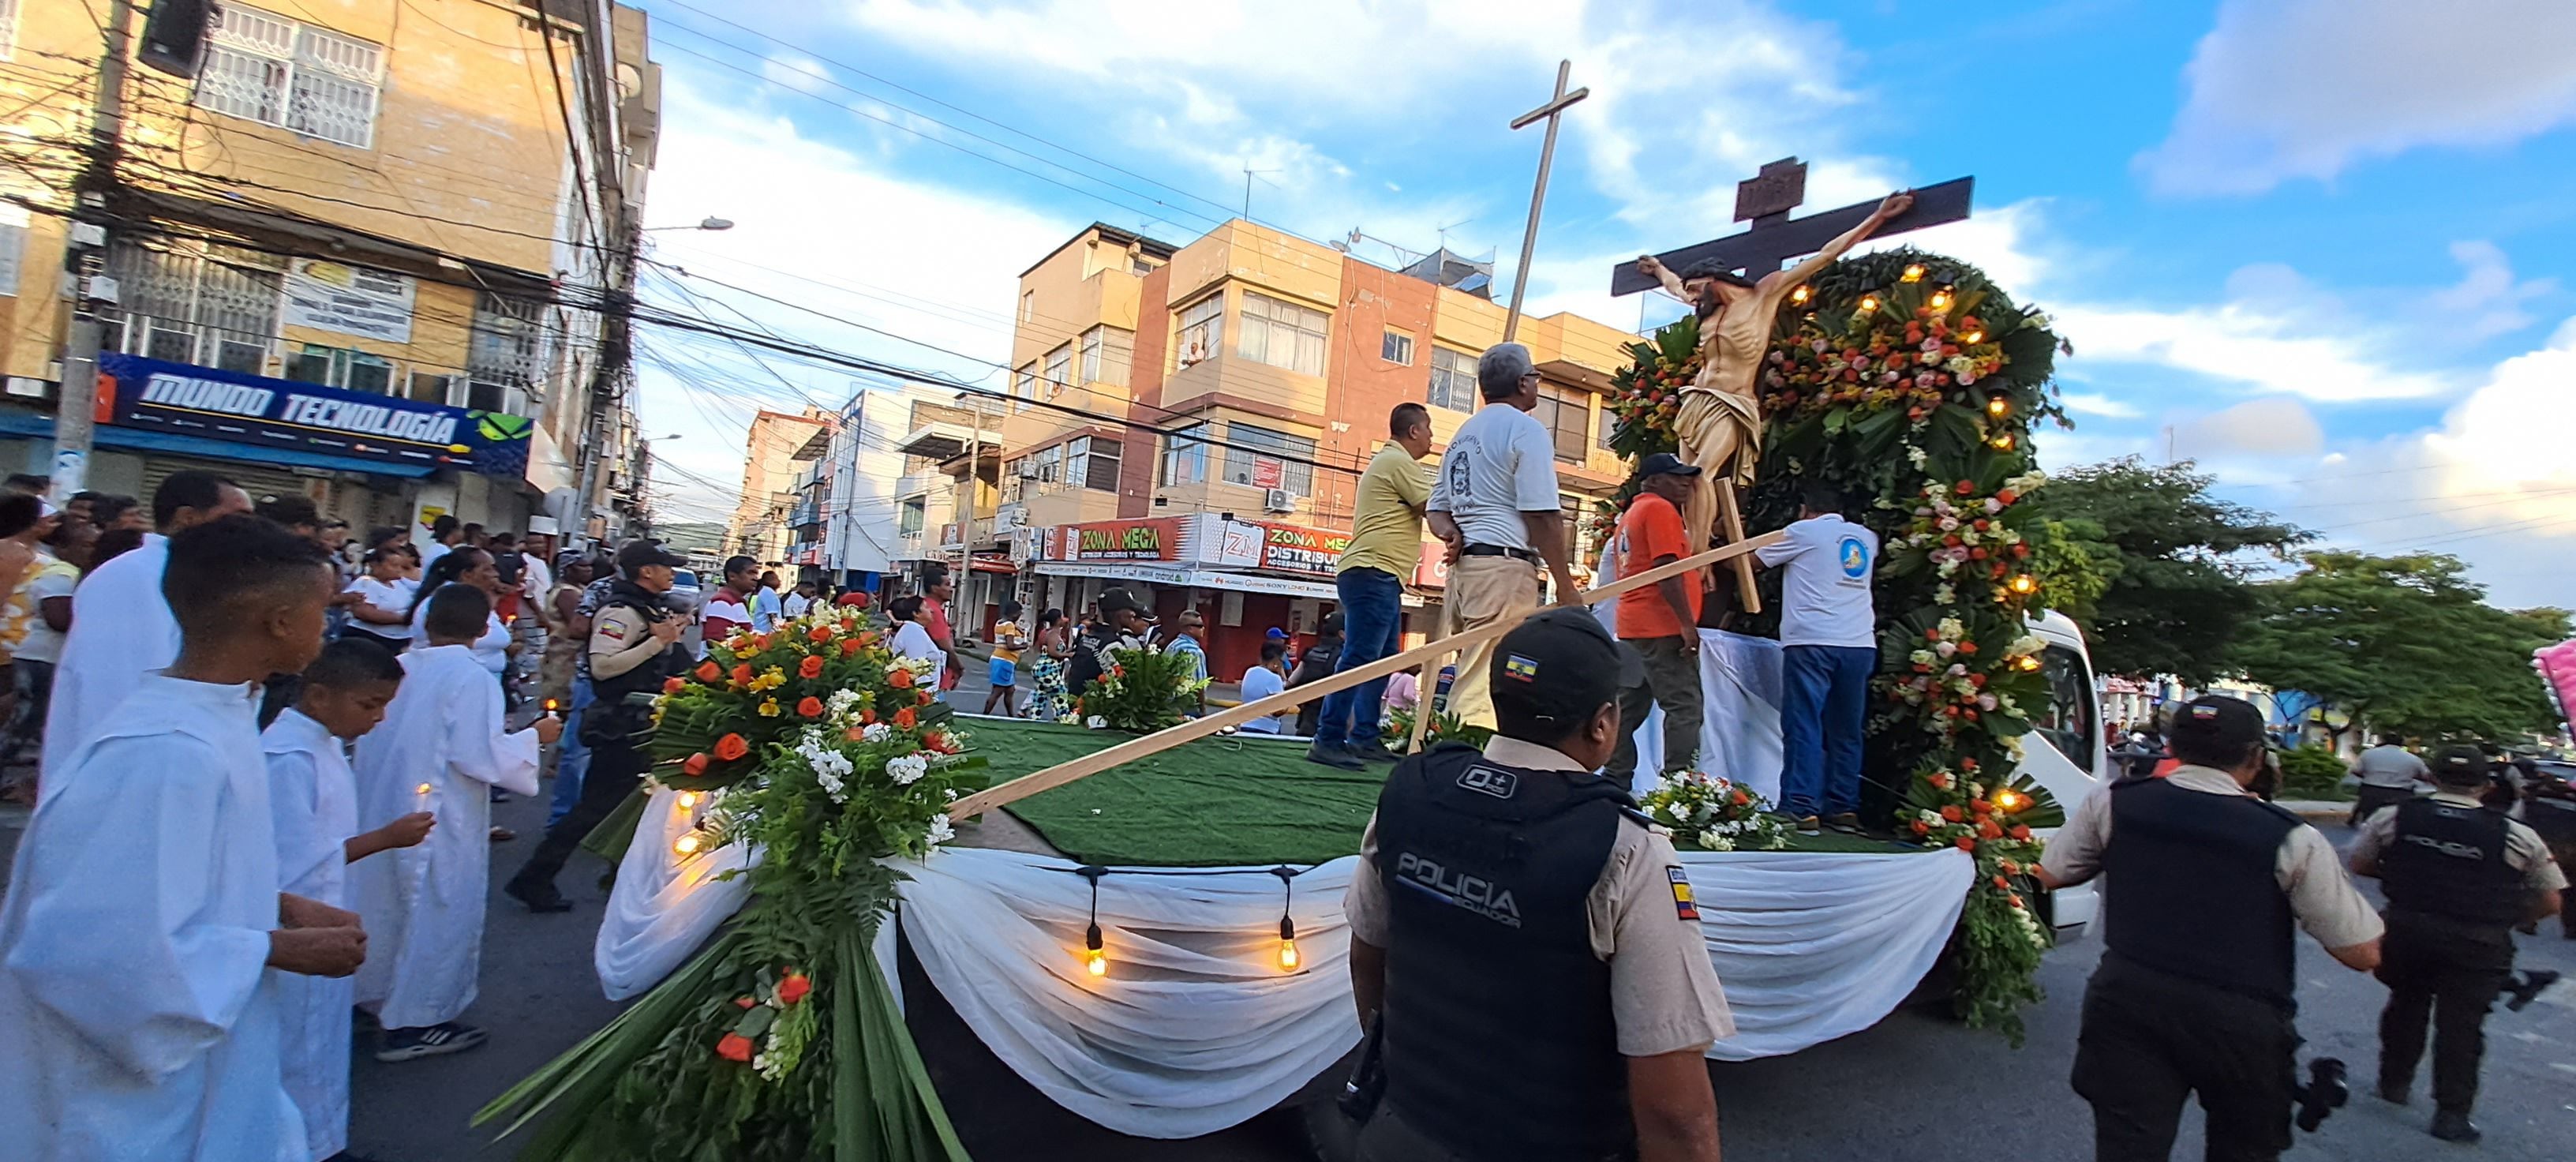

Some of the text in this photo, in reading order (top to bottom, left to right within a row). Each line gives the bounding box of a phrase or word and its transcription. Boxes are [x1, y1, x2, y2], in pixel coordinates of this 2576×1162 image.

[140, 373, 458, 446] MUNDO TECNOLOGÍA
[1081, 527, 1160, 550] ZONA MEGA
[1269, 529, 1316, 548] ZONA
[1267, 559, 1312, 569] ACCESORIOS
